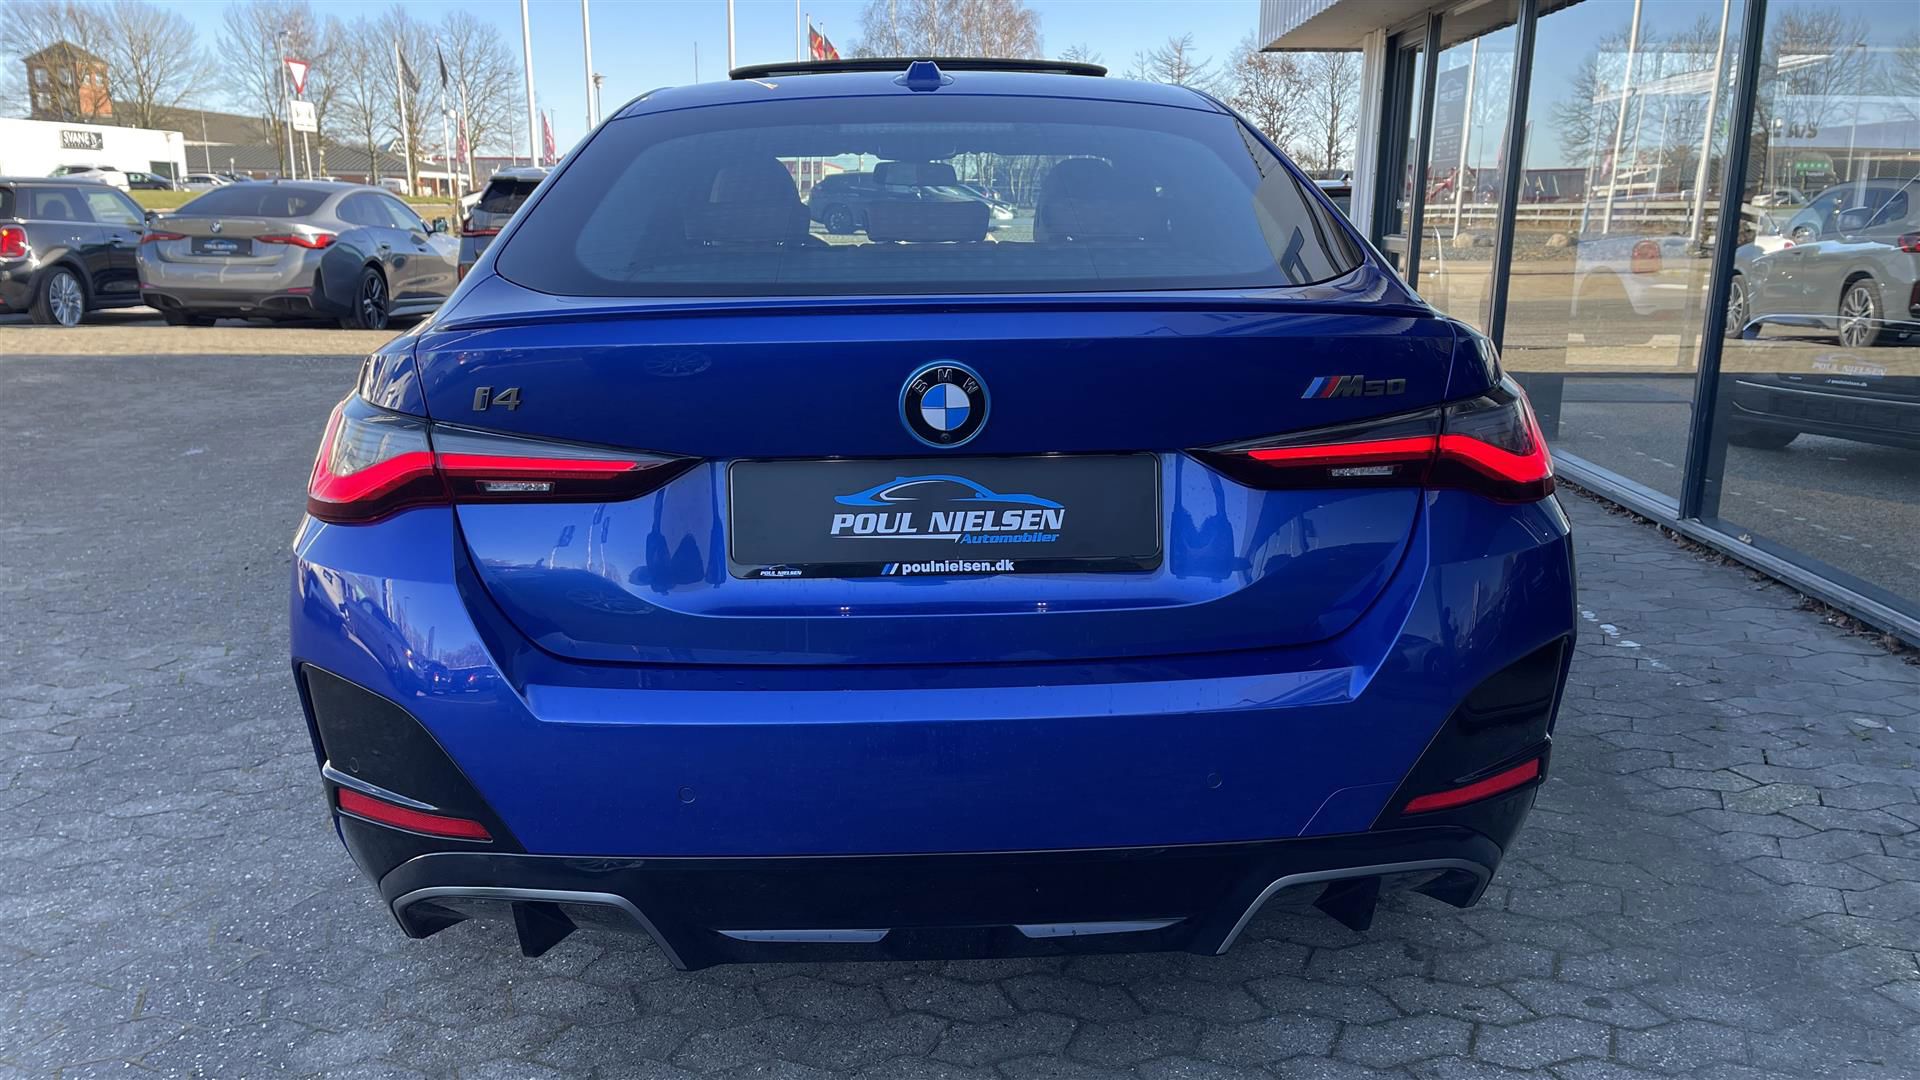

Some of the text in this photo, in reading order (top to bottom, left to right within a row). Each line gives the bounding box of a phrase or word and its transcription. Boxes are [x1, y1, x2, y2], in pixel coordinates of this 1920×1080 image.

[911, 368, 980, 395] BMW
[1328, 375, 1406, 398] M50
[472, 386, 521, 411] i4
[830, 509, 1066, 535] POUL NIELSEN
[960, 532, 1060, 544] Automobiler
[902, 560, 1015, 576] poulnielsen.dk
